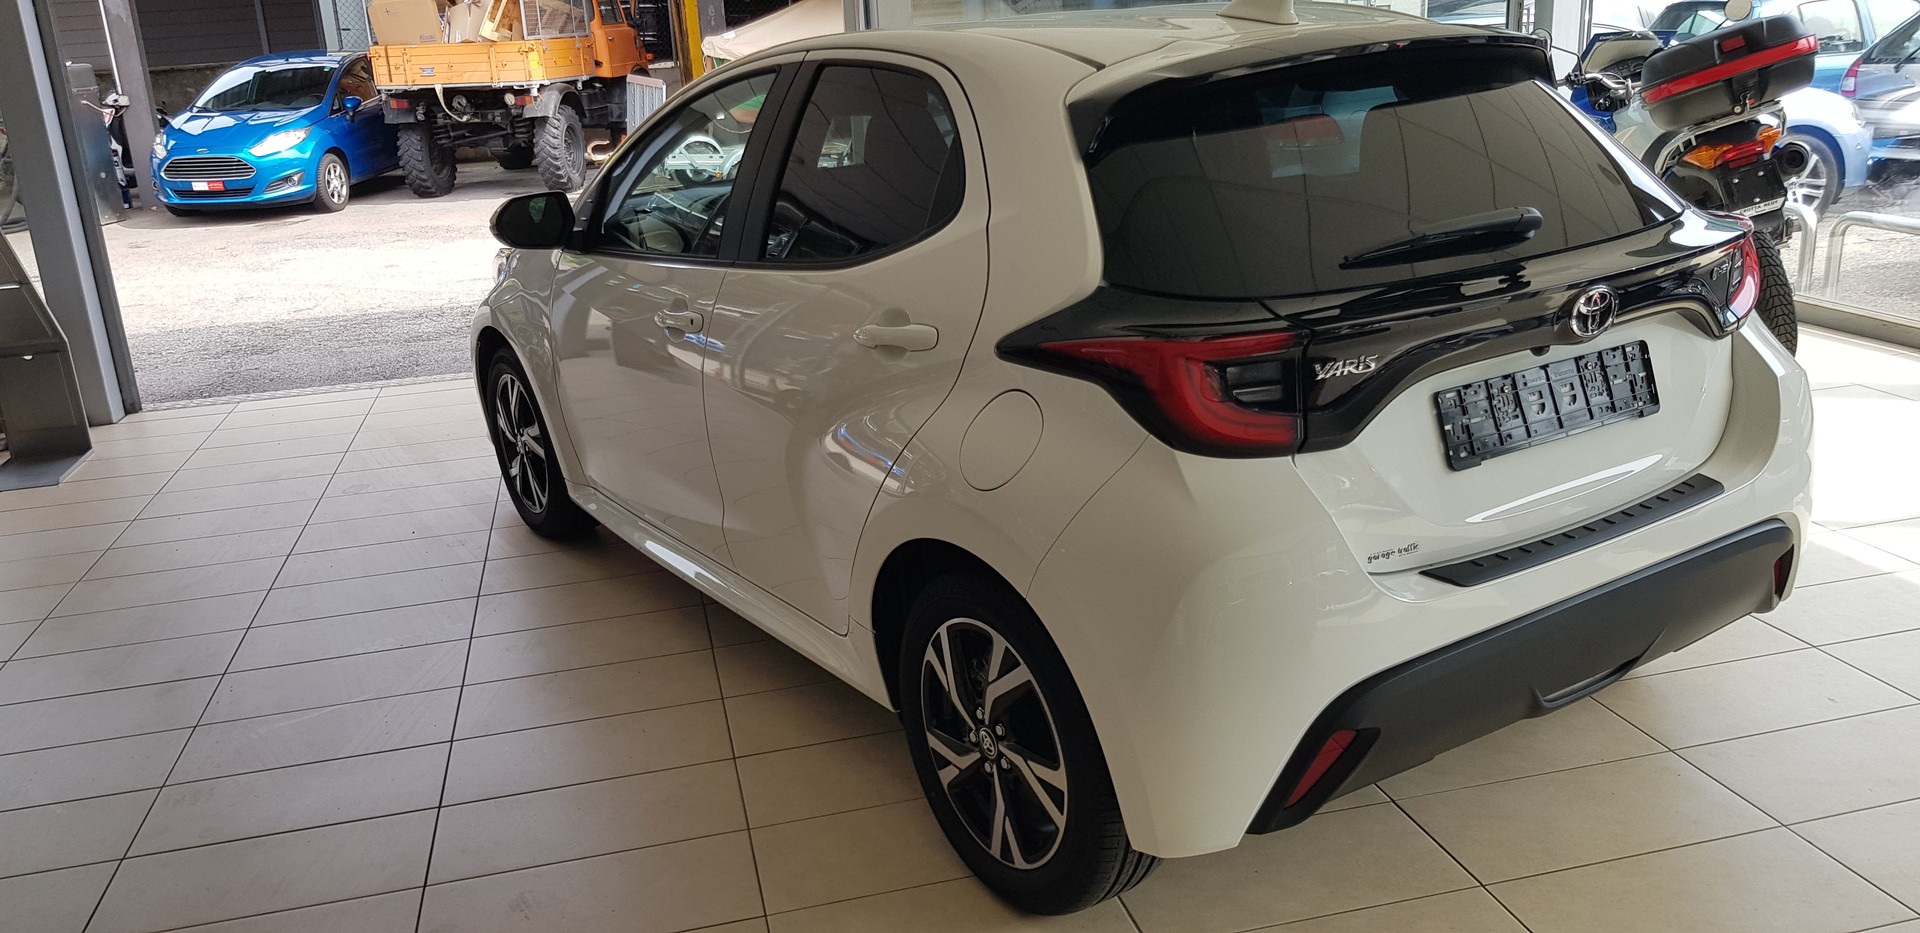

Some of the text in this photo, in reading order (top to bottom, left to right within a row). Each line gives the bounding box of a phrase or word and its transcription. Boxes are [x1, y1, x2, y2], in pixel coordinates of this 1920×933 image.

[1314, 354, 1379, 381] YARIS
[1367, 550, 1396, 564] garage
[1397, 542, 1420, 554] traffic
